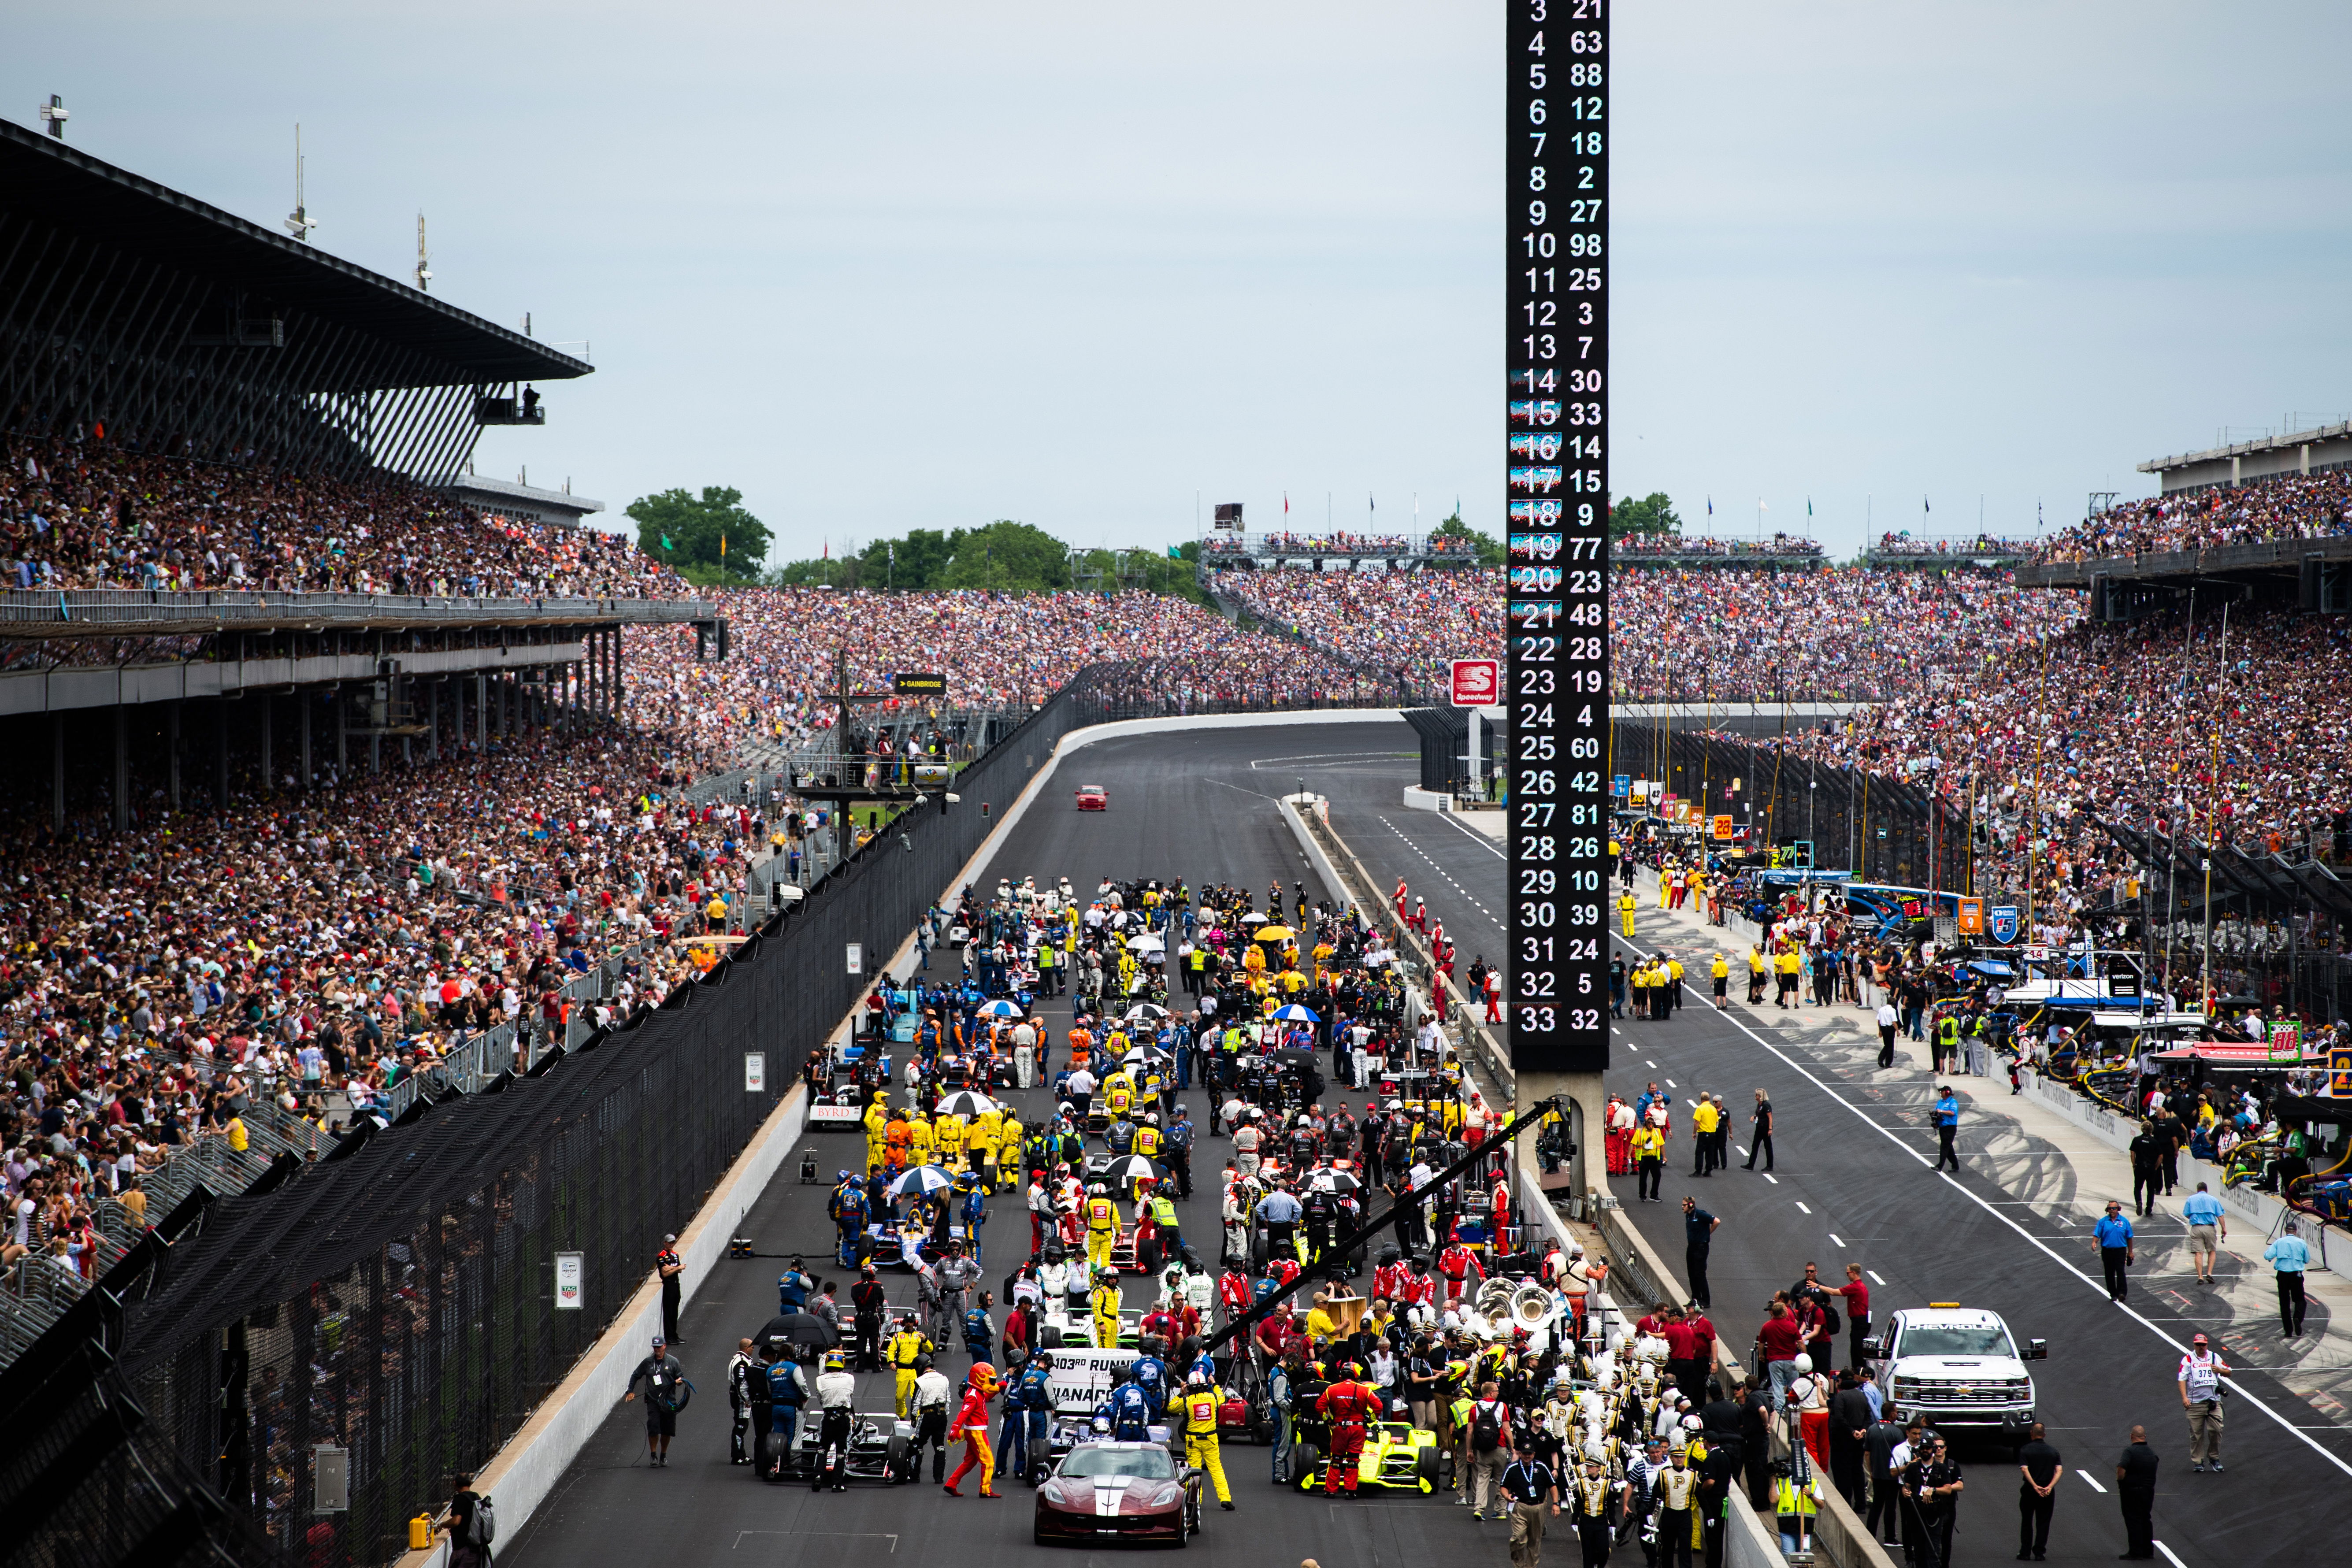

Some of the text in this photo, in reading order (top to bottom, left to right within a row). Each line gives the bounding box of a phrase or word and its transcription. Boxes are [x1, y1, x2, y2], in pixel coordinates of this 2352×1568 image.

[1531, 0, 1601, 21] 3 21
[1528, 31, 1602, 56] 4 63
[1530, 63, 1602, 89] 5 88
[1530, 97, 1602, 124] 6 12
[1530, 132, 1601, 157] 7 18
[1530, 166, 1593, 191] 8 2
[1529, 200, 1602, 225] 9 27
[1523, 233, 1601, 257] 10 98
[1526, 267, 1601, 292] 11 25
[1524, 301, 1592, 326] 12 3
[1524, 334, 1592, 359] 13 7
[1524, 369, 1601, 393] 14 30
[1524, 401, 1601, 425] 15 33
[1524, 436, 1601, 460] 16 14
[1525, 469, 1601, 493] 17 15
[1525, 502, 1593, 526] 18 9
[1525, 536, 1601, 560] 19 77
[1520, 568, 1601, 593] 20 23
[1522, 604, 1601, 628] 21 48
[1521, 637, 1601, 661] 22 28
[1521, 670, 1601, 693] 23 19
[1456, 693, 1494, 701] Speedway
[1521, 703, 1592, 727] 24 4
[1521, 736, 1599, 760] 25 60
[1521, 771, 1599, 794] 26 42
[1521, 803, 1596, 827] 27 81
[1677, 804, 1688, 819] 7
[1691, 812, 1703, 821] 48
[1716, 820, 1730, 834] 28
[1737, 827, 1744, 838] 4
[1521, 836, 1598, 860] 28 26
[1781, 846, 1795, 859] 77
[1521, 870, 1598, 894] 29 10
[1521, 902, 1598, 927] 30 39
[1967, 917, 1974, 928] 9
[1996, 918, 2014, 934] 15
[1523, 937, 1598, 961] 31 24
[2069, 942, 2085, 956] 30
[1521, 972, 1591, 996] 32 5
[1521, 1007, 1598, 1031] 33 32
[2273, 1031, 2298, 1052] 88
[2334, 1057, 2352, 1089] 2
[818, 1108, 850, 1117] BYRD
[1056, 1358, 1086, 1370] 103RD
[1555, 1409, 1566, 1420] P
[1589, 1483, 1600, 1495] P
[1673, 1476, 1685, 1489] P
